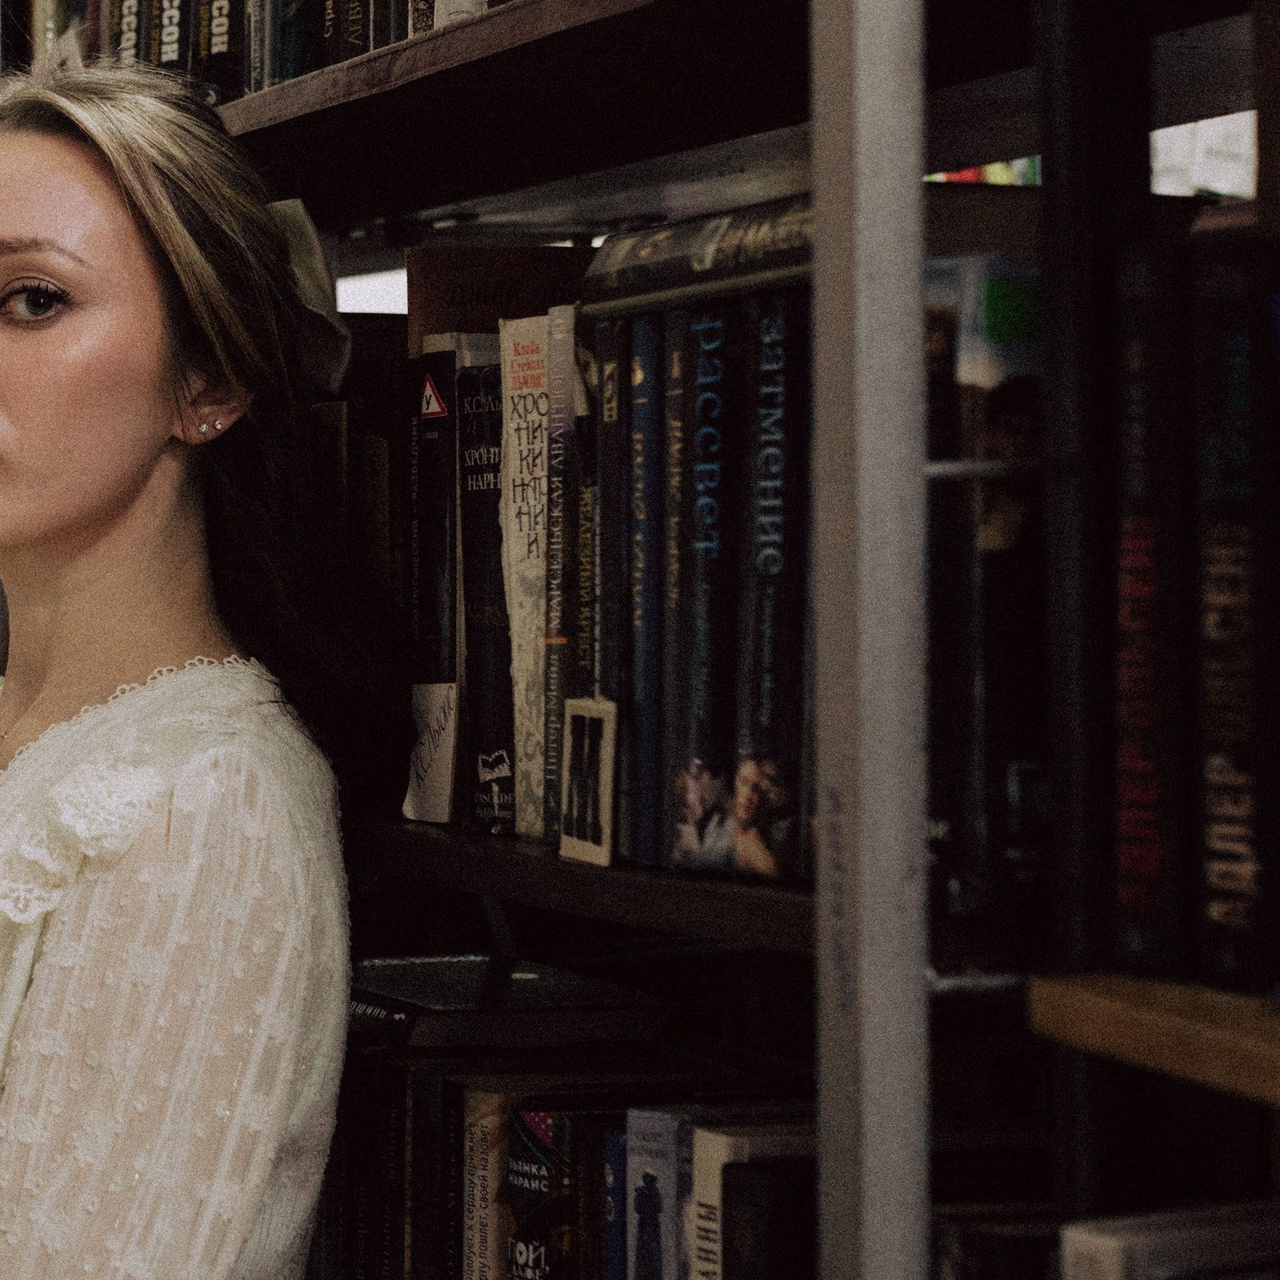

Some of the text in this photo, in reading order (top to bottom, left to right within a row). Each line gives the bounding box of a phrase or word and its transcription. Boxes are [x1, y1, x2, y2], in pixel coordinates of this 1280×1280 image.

[547, 476, 566, 629] МАРСЕЛЬСКАЯ
[689, 316, 724, 560] рассвет
[757, 312, 787, 575] затмение
